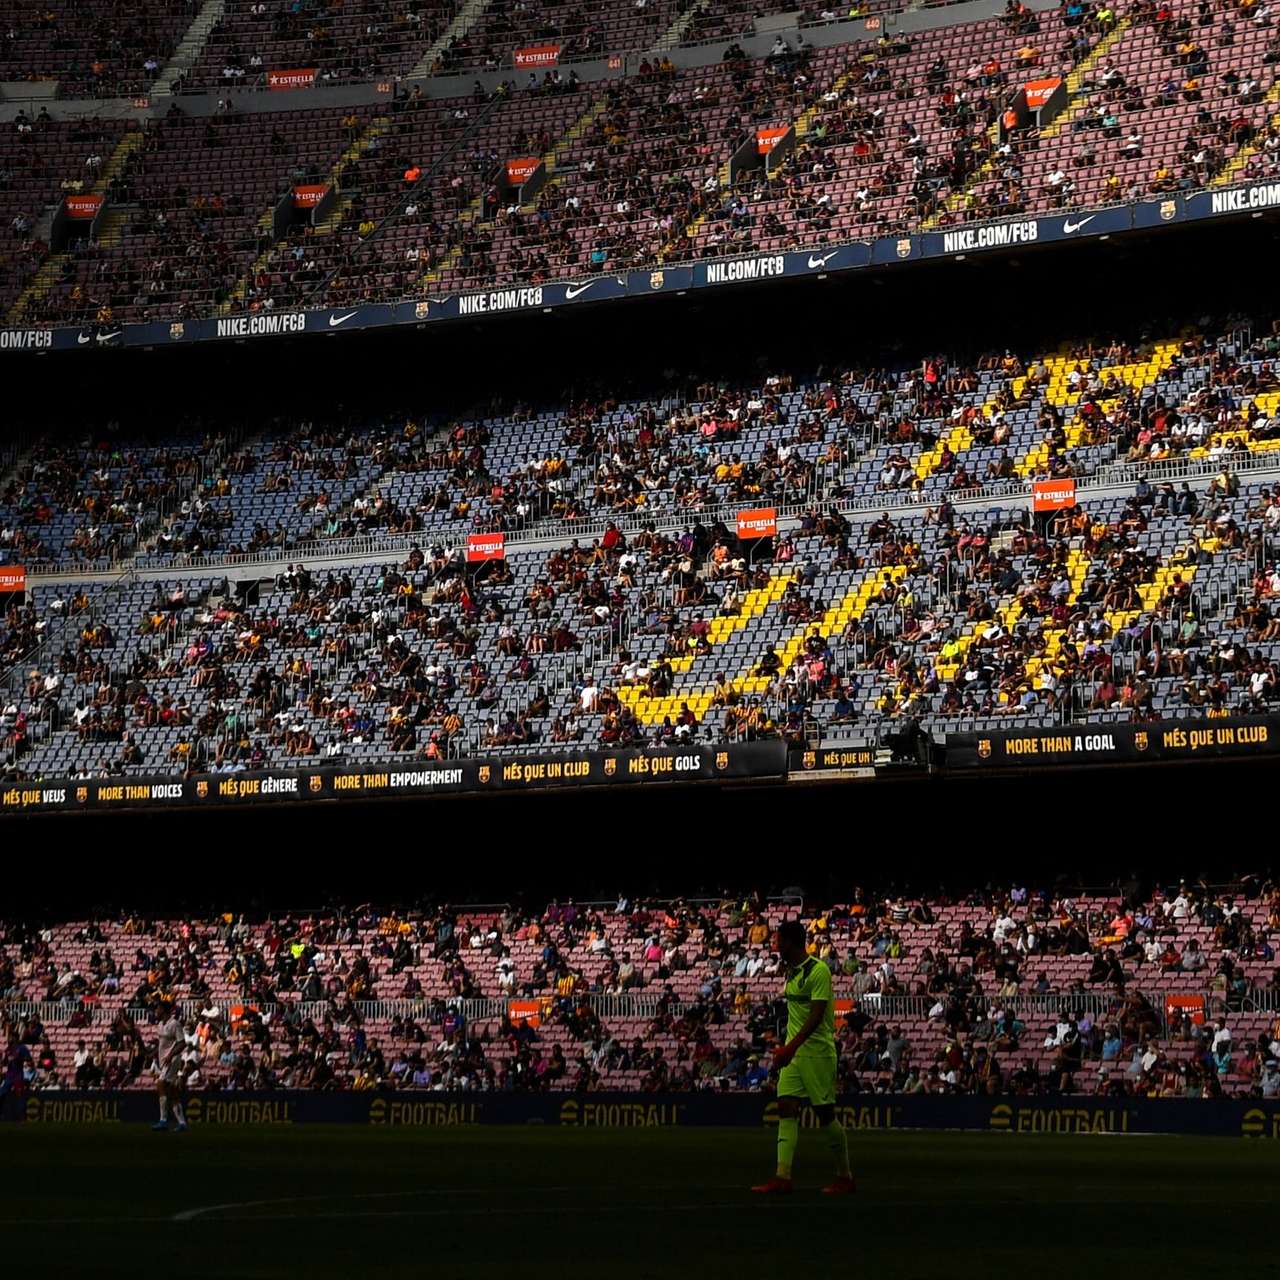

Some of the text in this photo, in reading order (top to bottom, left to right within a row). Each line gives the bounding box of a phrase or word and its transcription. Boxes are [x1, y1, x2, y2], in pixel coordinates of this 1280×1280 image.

[943, 221, 1038, 254] NIKE.COM/FCB
[459, 288, 543, 315] NIKE.COM/FCB
[217, 313, 306, 338] NIKE.COM/FCB
[1043, 490, 1074, 500] ESTRELLA
[746, 519, 776, 528] ESTRELLA
[476, 543, 503, 551] ESTRELLA
[1006, 734, 1116, 755] MORE THAN A GOAL
[1163, 726, 1269, 749] MÉS QUE UN CLUB
[629, 754, 701, 775] MÉS QUE GOLS
[824, 751, 840, 766] MÉS
[841, 753, 857, 768] QUE
[858, 751, 870, 764] UN
[334, 768, 464, 790] MORE THAN EMPOWERMENT
[503, 761, 590, 782] MÉS QUE UN CLUB
[98, 783, 183, 802] MORE THAN VOICES
[219, 776, 298, 797] MÉS QUE GÈNERE
[3, 788, 67, 807] MÉS QUE VEUS
